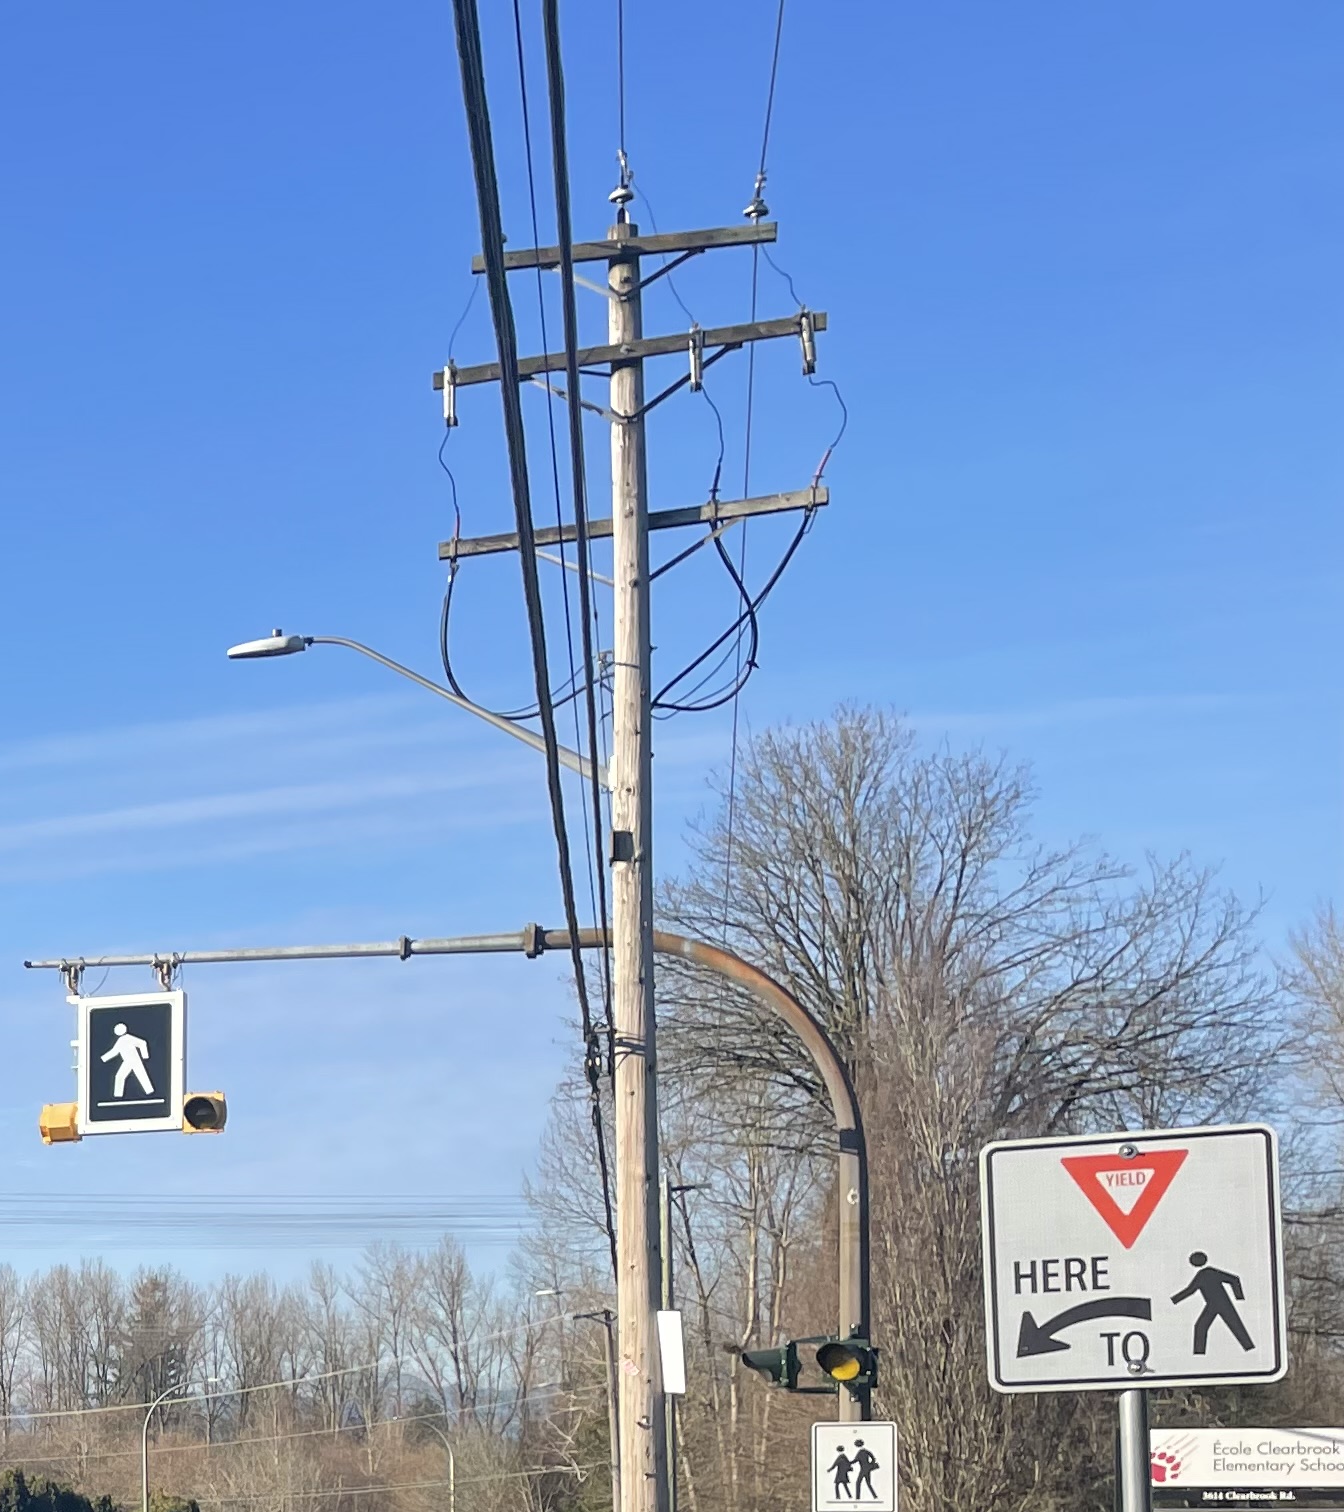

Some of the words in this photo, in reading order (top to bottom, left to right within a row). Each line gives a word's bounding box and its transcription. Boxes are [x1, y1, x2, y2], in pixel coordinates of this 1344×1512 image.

[1105, 1172, 1146, 1188] YIELD
[1013, 1255, 1111, 1295] HERE
[1099, 1330, 1150, 1367] TO
[1213, 1440, 1252, 1456] École
[1257, 1440, 1340, 1456] Clearbrook
[1213, 1459, 1295, 1475] Elementary
[1225, 1491, 1277, 1501] Clearbrook
